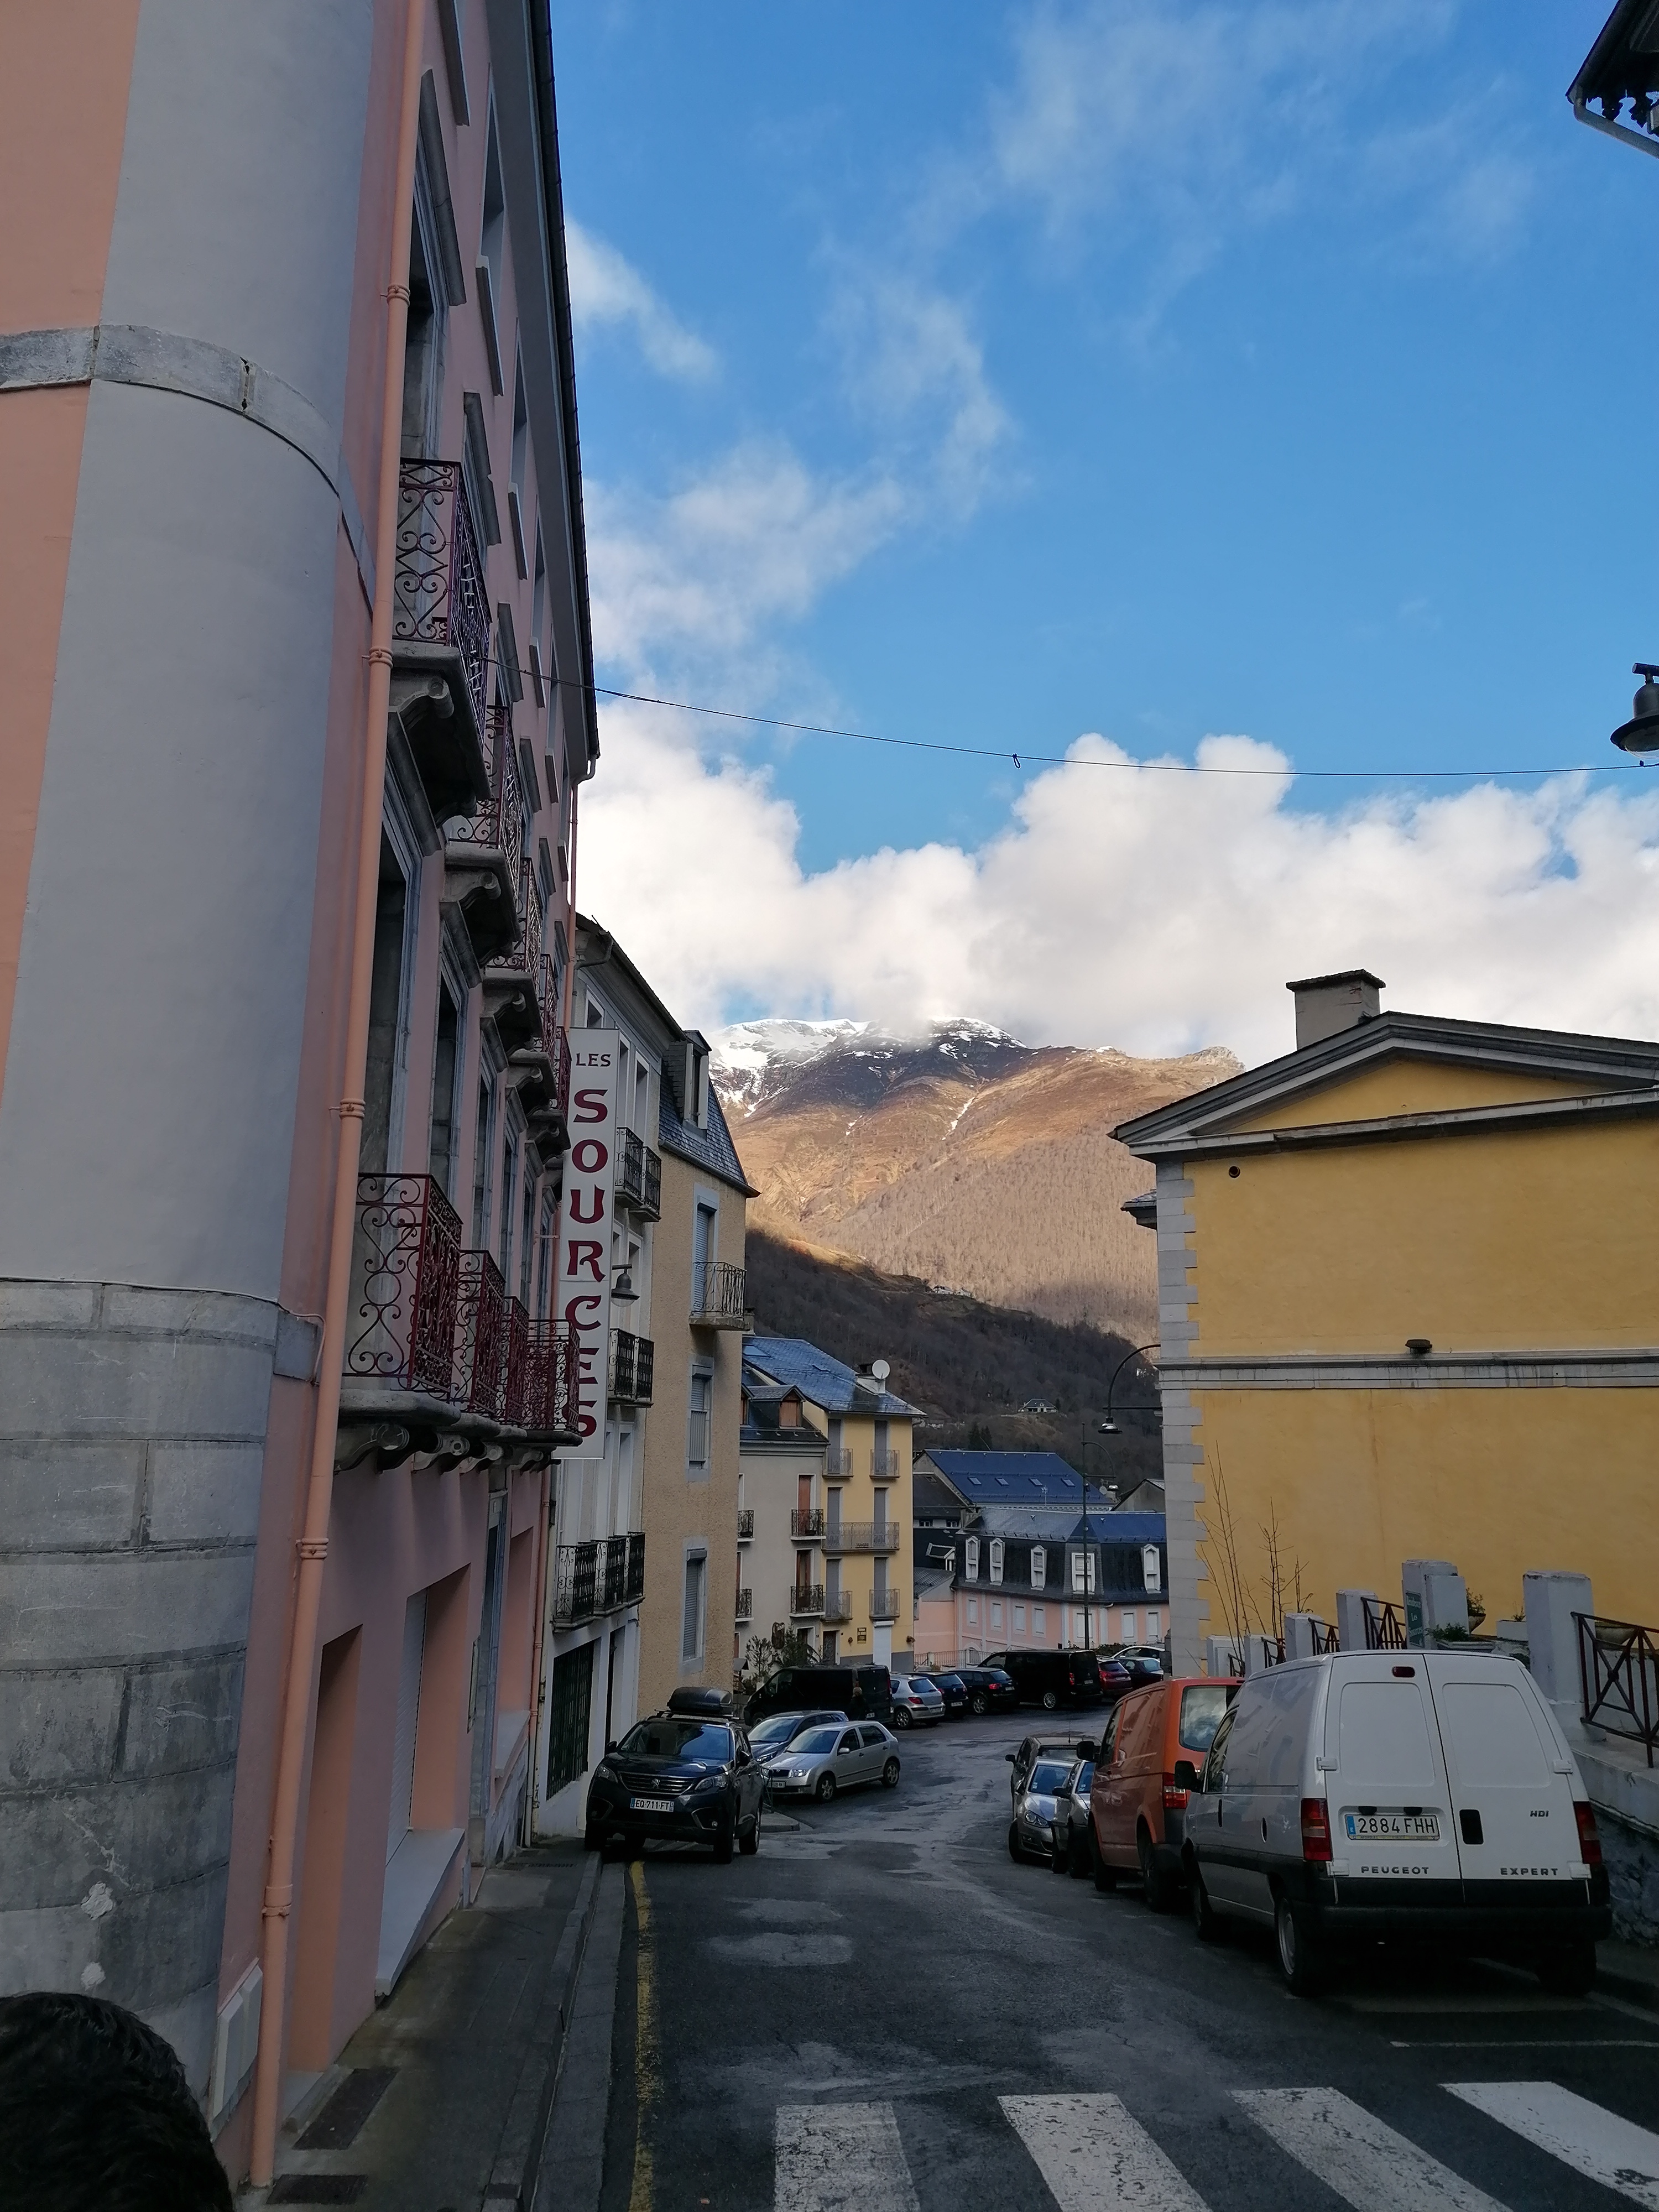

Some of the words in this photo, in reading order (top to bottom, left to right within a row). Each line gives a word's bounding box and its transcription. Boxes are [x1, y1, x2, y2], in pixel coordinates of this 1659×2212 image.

[576, 1053, 611, 1067] LES
[1358, 1818, 1400, 1833] 2884
[1404, 1818, 1435, 1833] FHH
[1361, 1866, 1429, 1874] PEUGEOT
